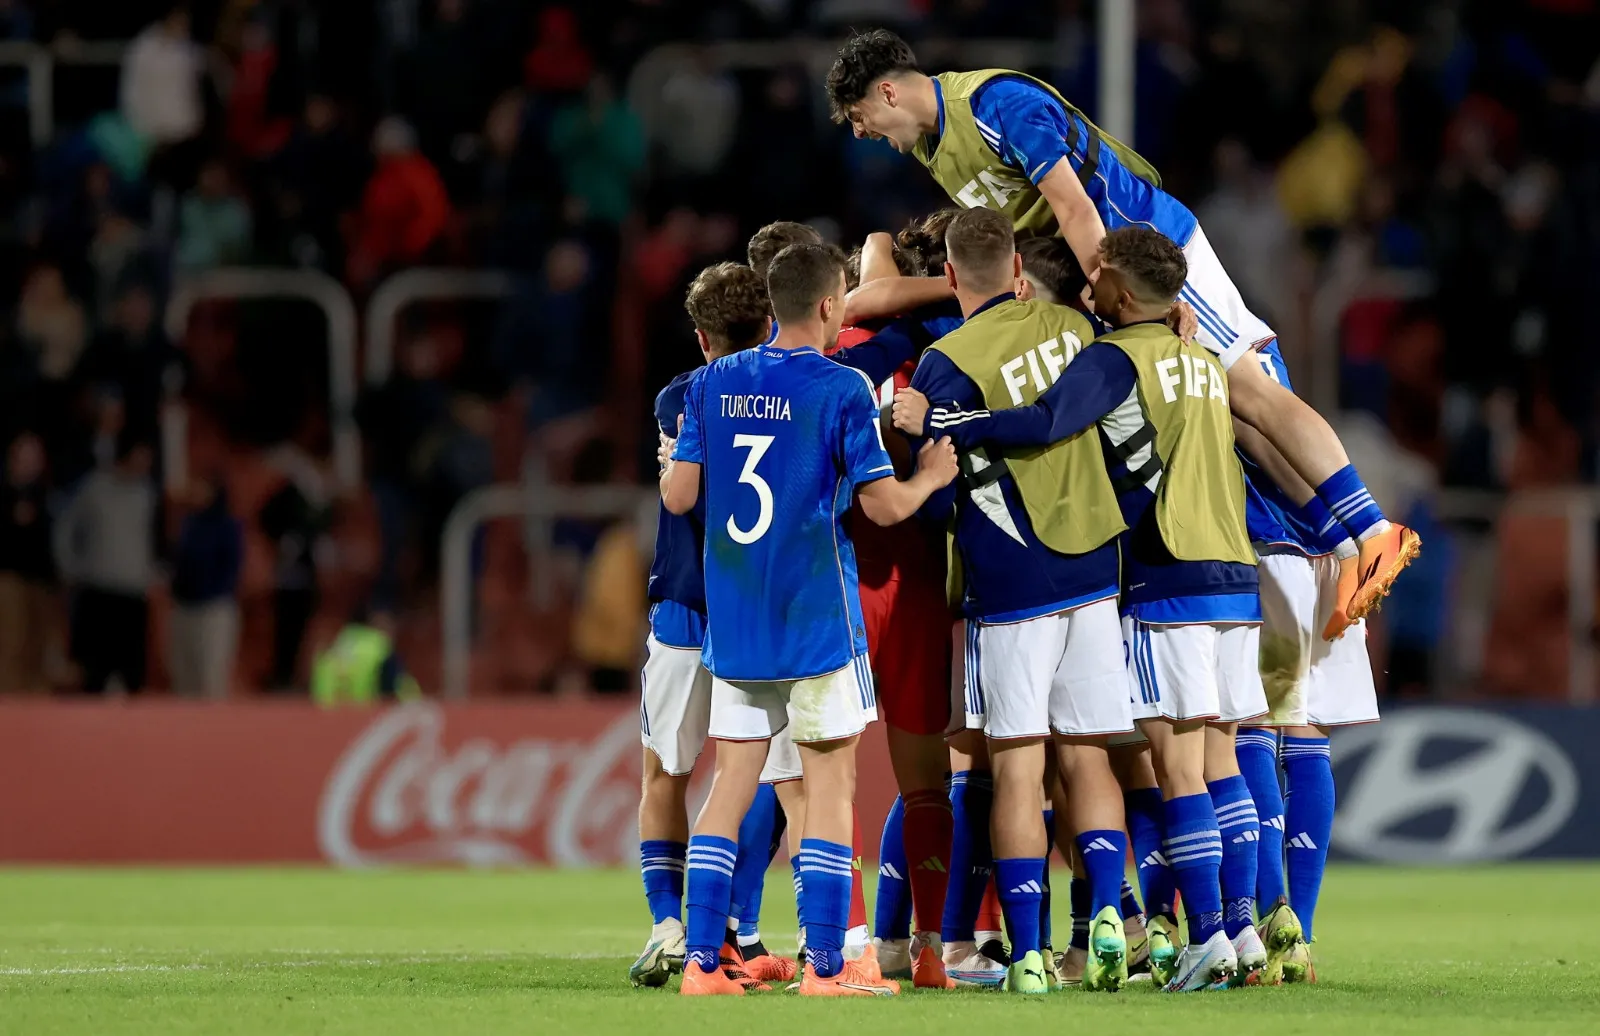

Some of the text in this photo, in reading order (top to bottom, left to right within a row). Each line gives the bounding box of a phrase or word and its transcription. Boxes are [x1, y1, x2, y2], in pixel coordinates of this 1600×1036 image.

[1155, 353, 1227, 406] FIFA
[720, 394, 792, 421] TURICCHIA
[726, 433, 776, 545] 3
